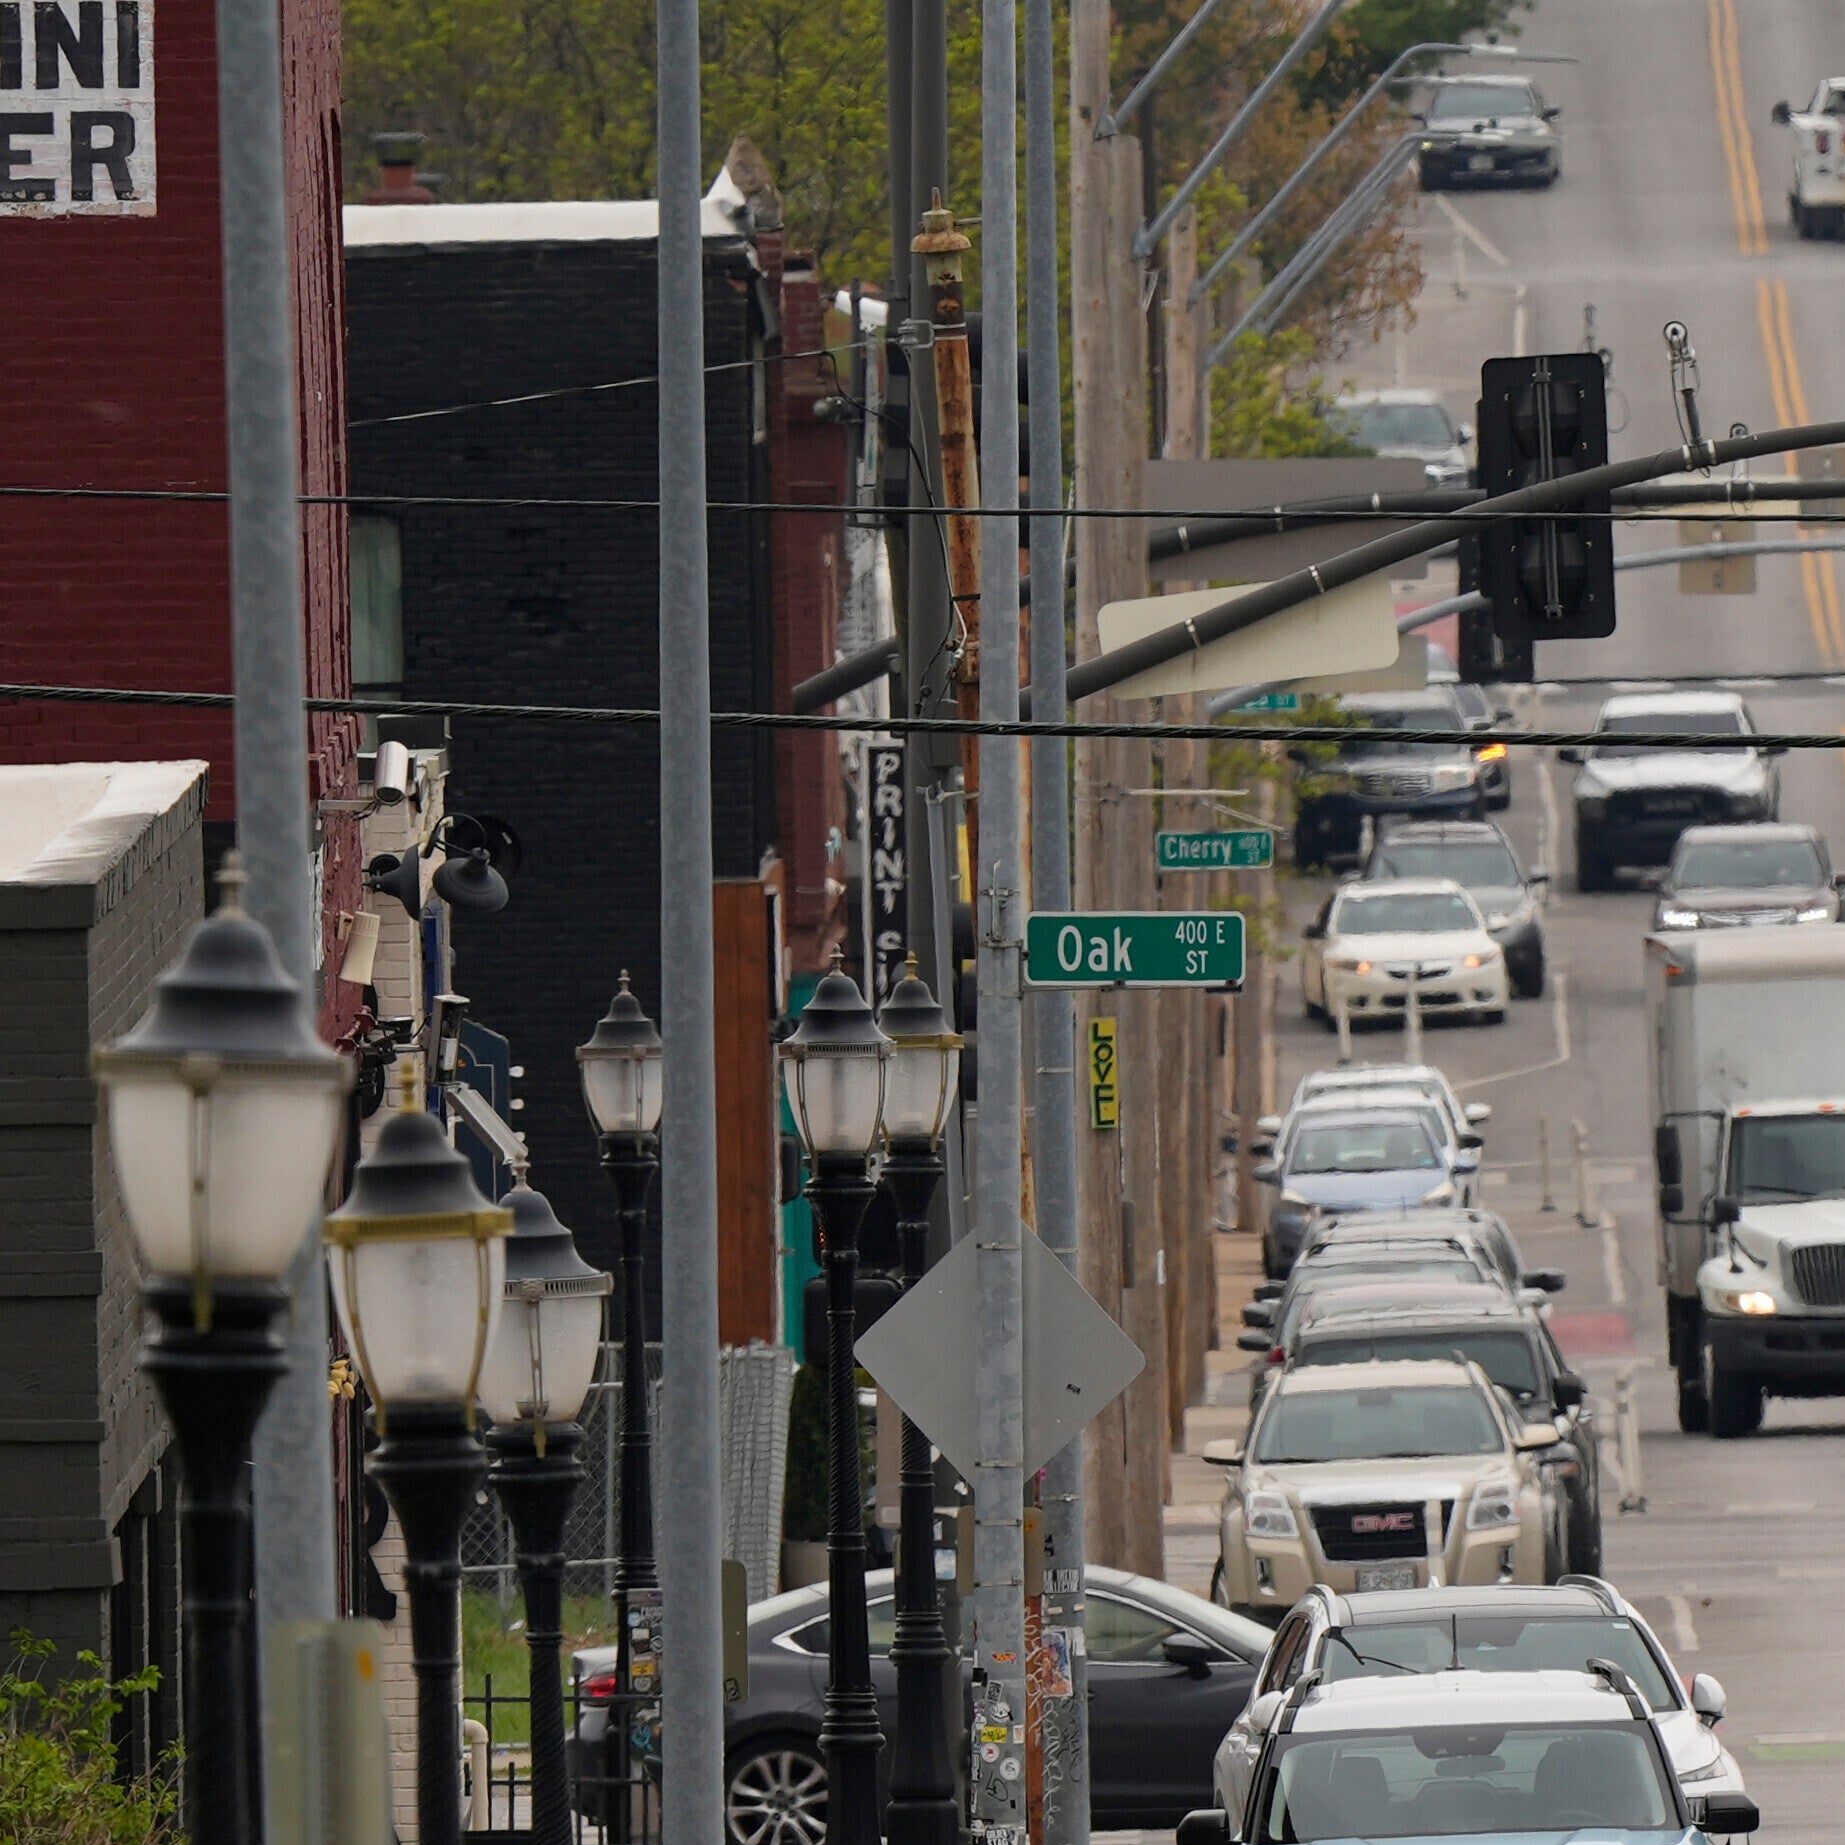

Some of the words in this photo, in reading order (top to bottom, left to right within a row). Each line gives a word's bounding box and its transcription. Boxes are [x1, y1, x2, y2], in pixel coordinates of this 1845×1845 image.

[874, 751, 904, 914] PRINT
[1164, 836, 1233, 865] Cherry
[1057, 925, 1133, 973] Oak
[1174, 920, 1208, 945] 400
[1216, 920, 1226, 944] E
[1185, 950, 1209, 975] ST
[1351, 1512, 1415, 1533] GMC
